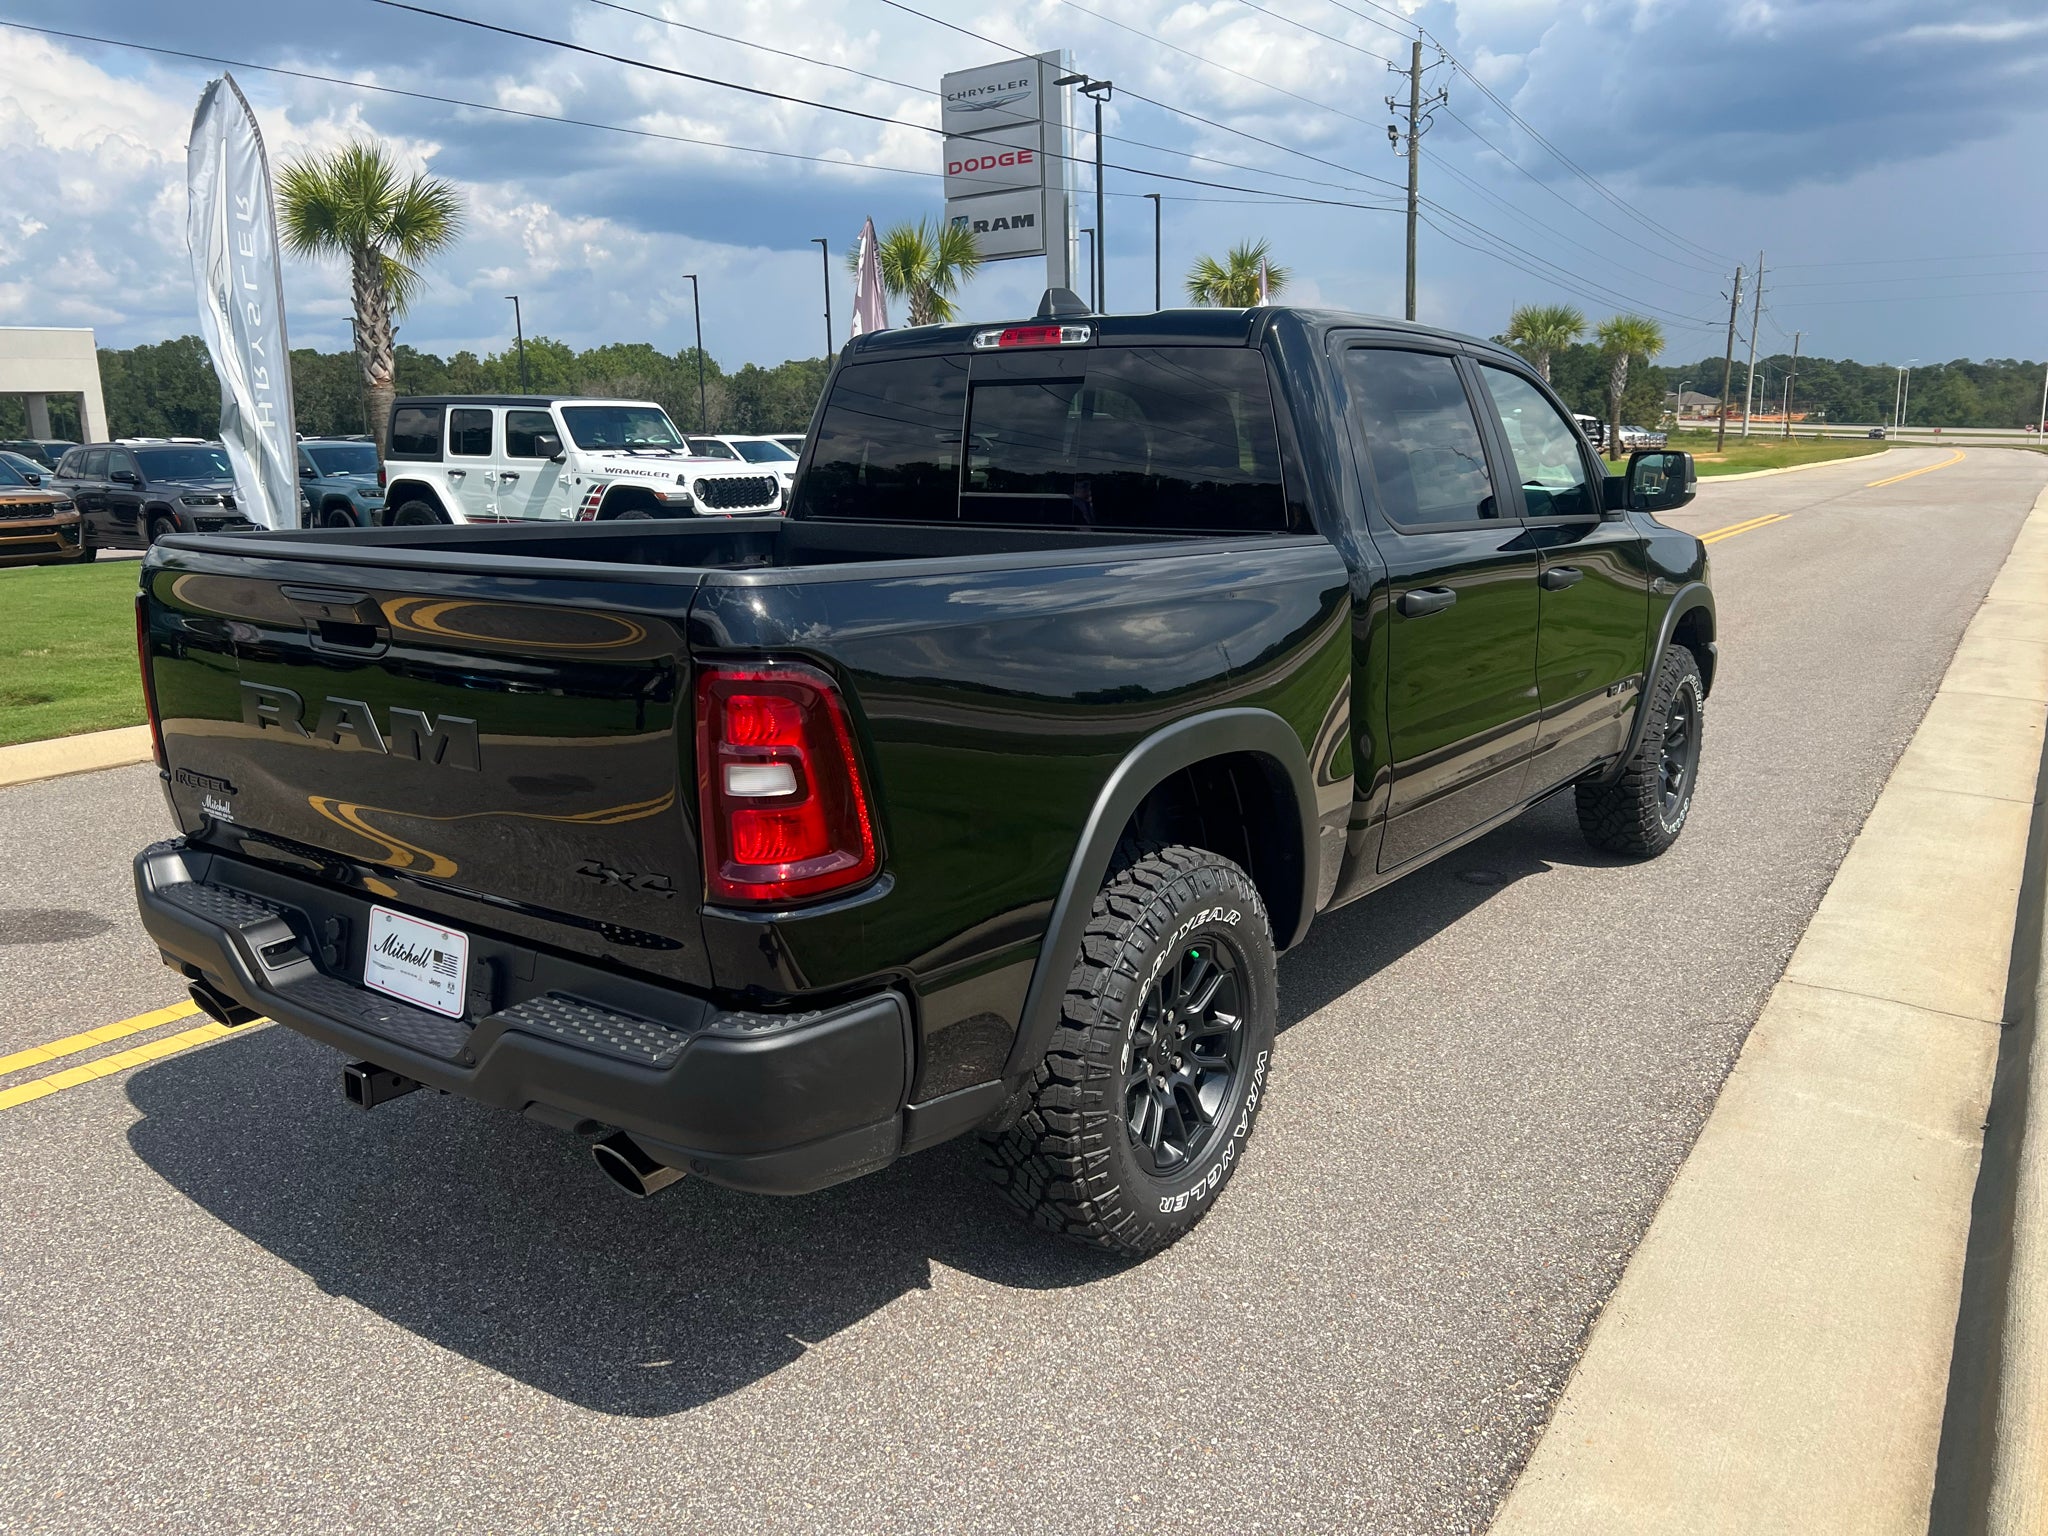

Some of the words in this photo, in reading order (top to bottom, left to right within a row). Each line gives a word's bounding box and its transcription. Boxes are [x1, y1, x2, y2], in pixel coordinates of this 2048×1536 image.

[947, 79, 1029, 101] CHRYSLER
[948, 150, 1033, 175] DODGE
[973, 213, 1035, 233] RAM
[604, 467, 670, 479] WRANGLER
[240, 680, 481, 772] RAM
[201, 794, 231, 814] Mitchell
[374, 932, 433, 969] Mitchell
[1120, 906, 1242, 1075] GOODYEAR
[1159, 1050, 1268, 1213] WRANGLER
